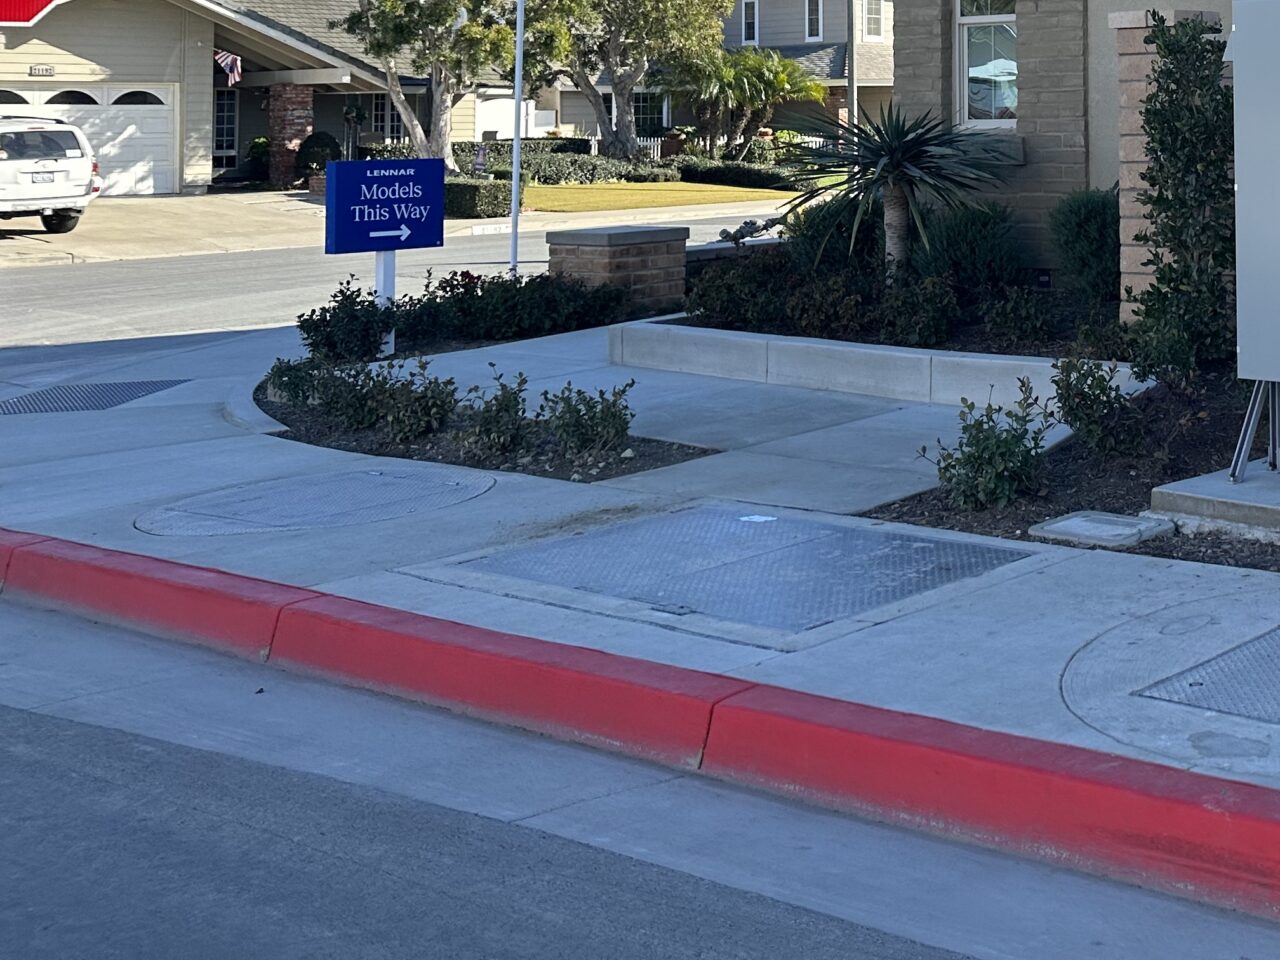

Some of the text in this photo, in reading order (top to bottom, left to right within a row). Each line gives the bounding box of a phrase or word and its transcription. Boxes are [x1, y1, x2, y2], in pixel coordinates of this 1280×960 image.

[366, 168, 416, 177] LENNAR
[360, 182, 422, 200] Models
[350, 203, 431, 222] This Way
